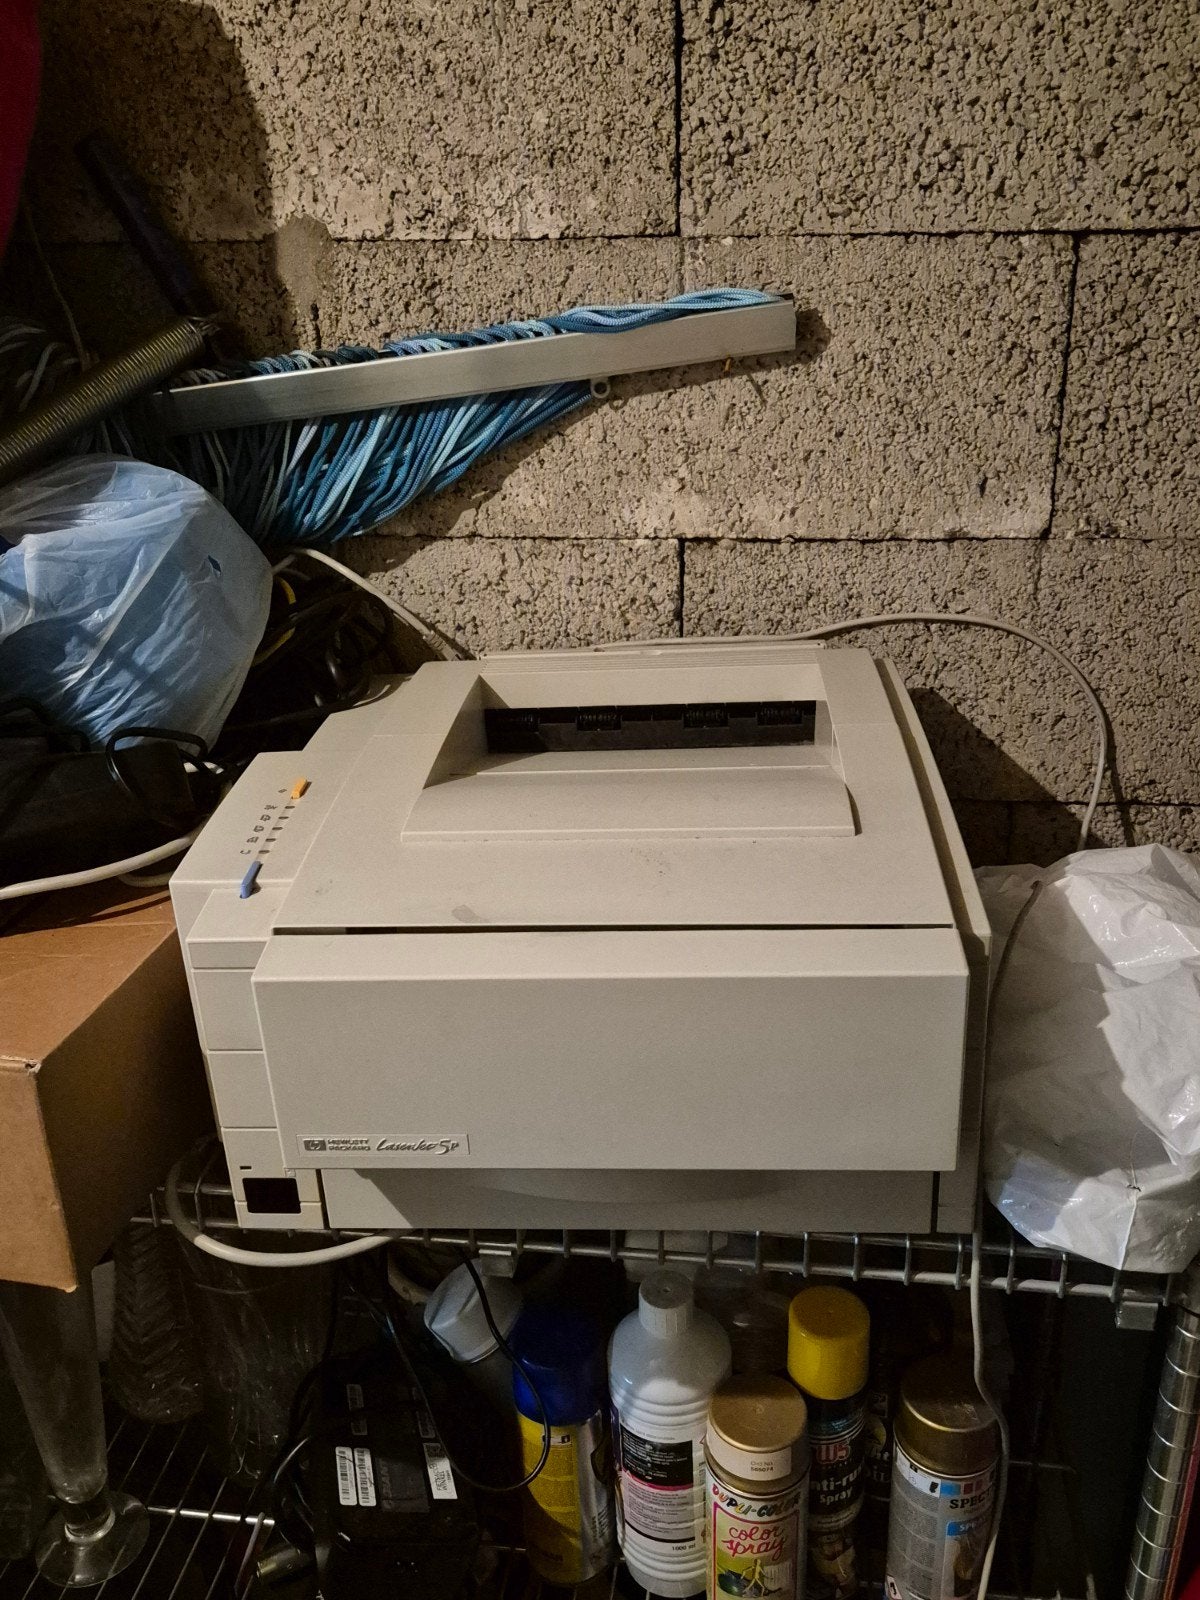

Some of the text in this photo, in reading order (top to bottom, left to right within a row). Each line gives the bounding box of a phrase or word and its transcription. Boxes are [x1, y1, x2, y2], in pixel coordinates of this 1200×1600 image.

[376, 1137, 437, 1152] LaserJet
[711, 1483, 801, 1518] DUPLI-COLOR
[728, 1525, 784, 1541] color
[721, 1537, 787, 1561] spray
